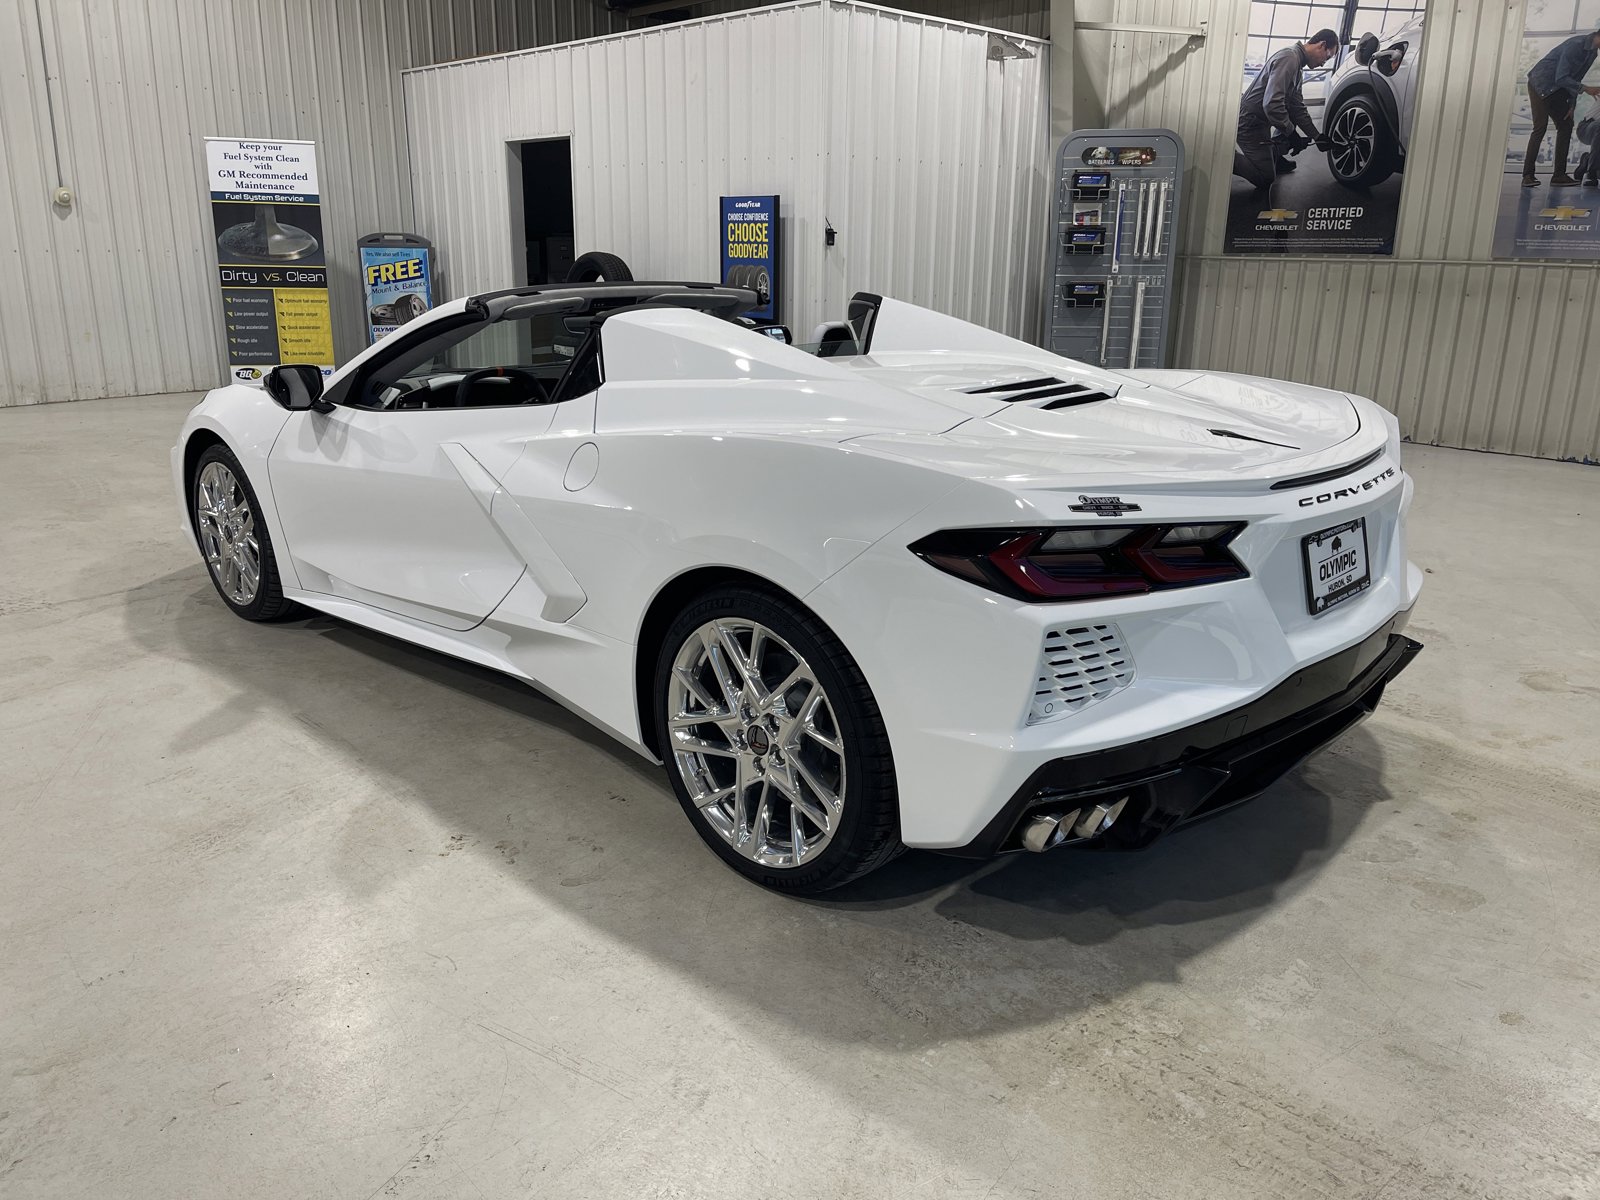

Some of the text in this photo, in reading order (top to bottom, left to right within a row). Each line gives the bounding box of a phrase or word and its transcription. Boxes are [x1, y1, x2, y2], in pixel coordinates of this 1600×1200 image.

[239, 143, 261, 152] Keep
[244, 153, 274, 163] System
[275, 155, 300, 163] Clean
[218, 170, 308, 181] GM Recommended
[235, 181, 295, 191] Maintenance
[735, 201, 760, 209] GOODYEAR
[727, 213, 768, 221] CHOOSE CONFIDENCE
[1307, 207, 1364, 218] CERTIFIED
[1306, 219, 1352, 230] SERVICE
[727, 222, 768, 242] CHOOSE
[728, 243, 768, 259] GOODYEAR
[221, 270, 325, 284] Dirty vs. Clean
[367, 258, 423, 286] FREE
[371, 286, 392, 295] Mount
[402, 282, 427, 290] Balance
[1298, 466, 1396, 507] CORVETTE
[1078, 495, 1121, 504] OLYMPIC
[1320, 550, 1357, 581] OLYMPIC
[1327, 574, 1353, 593] HURON, SD
